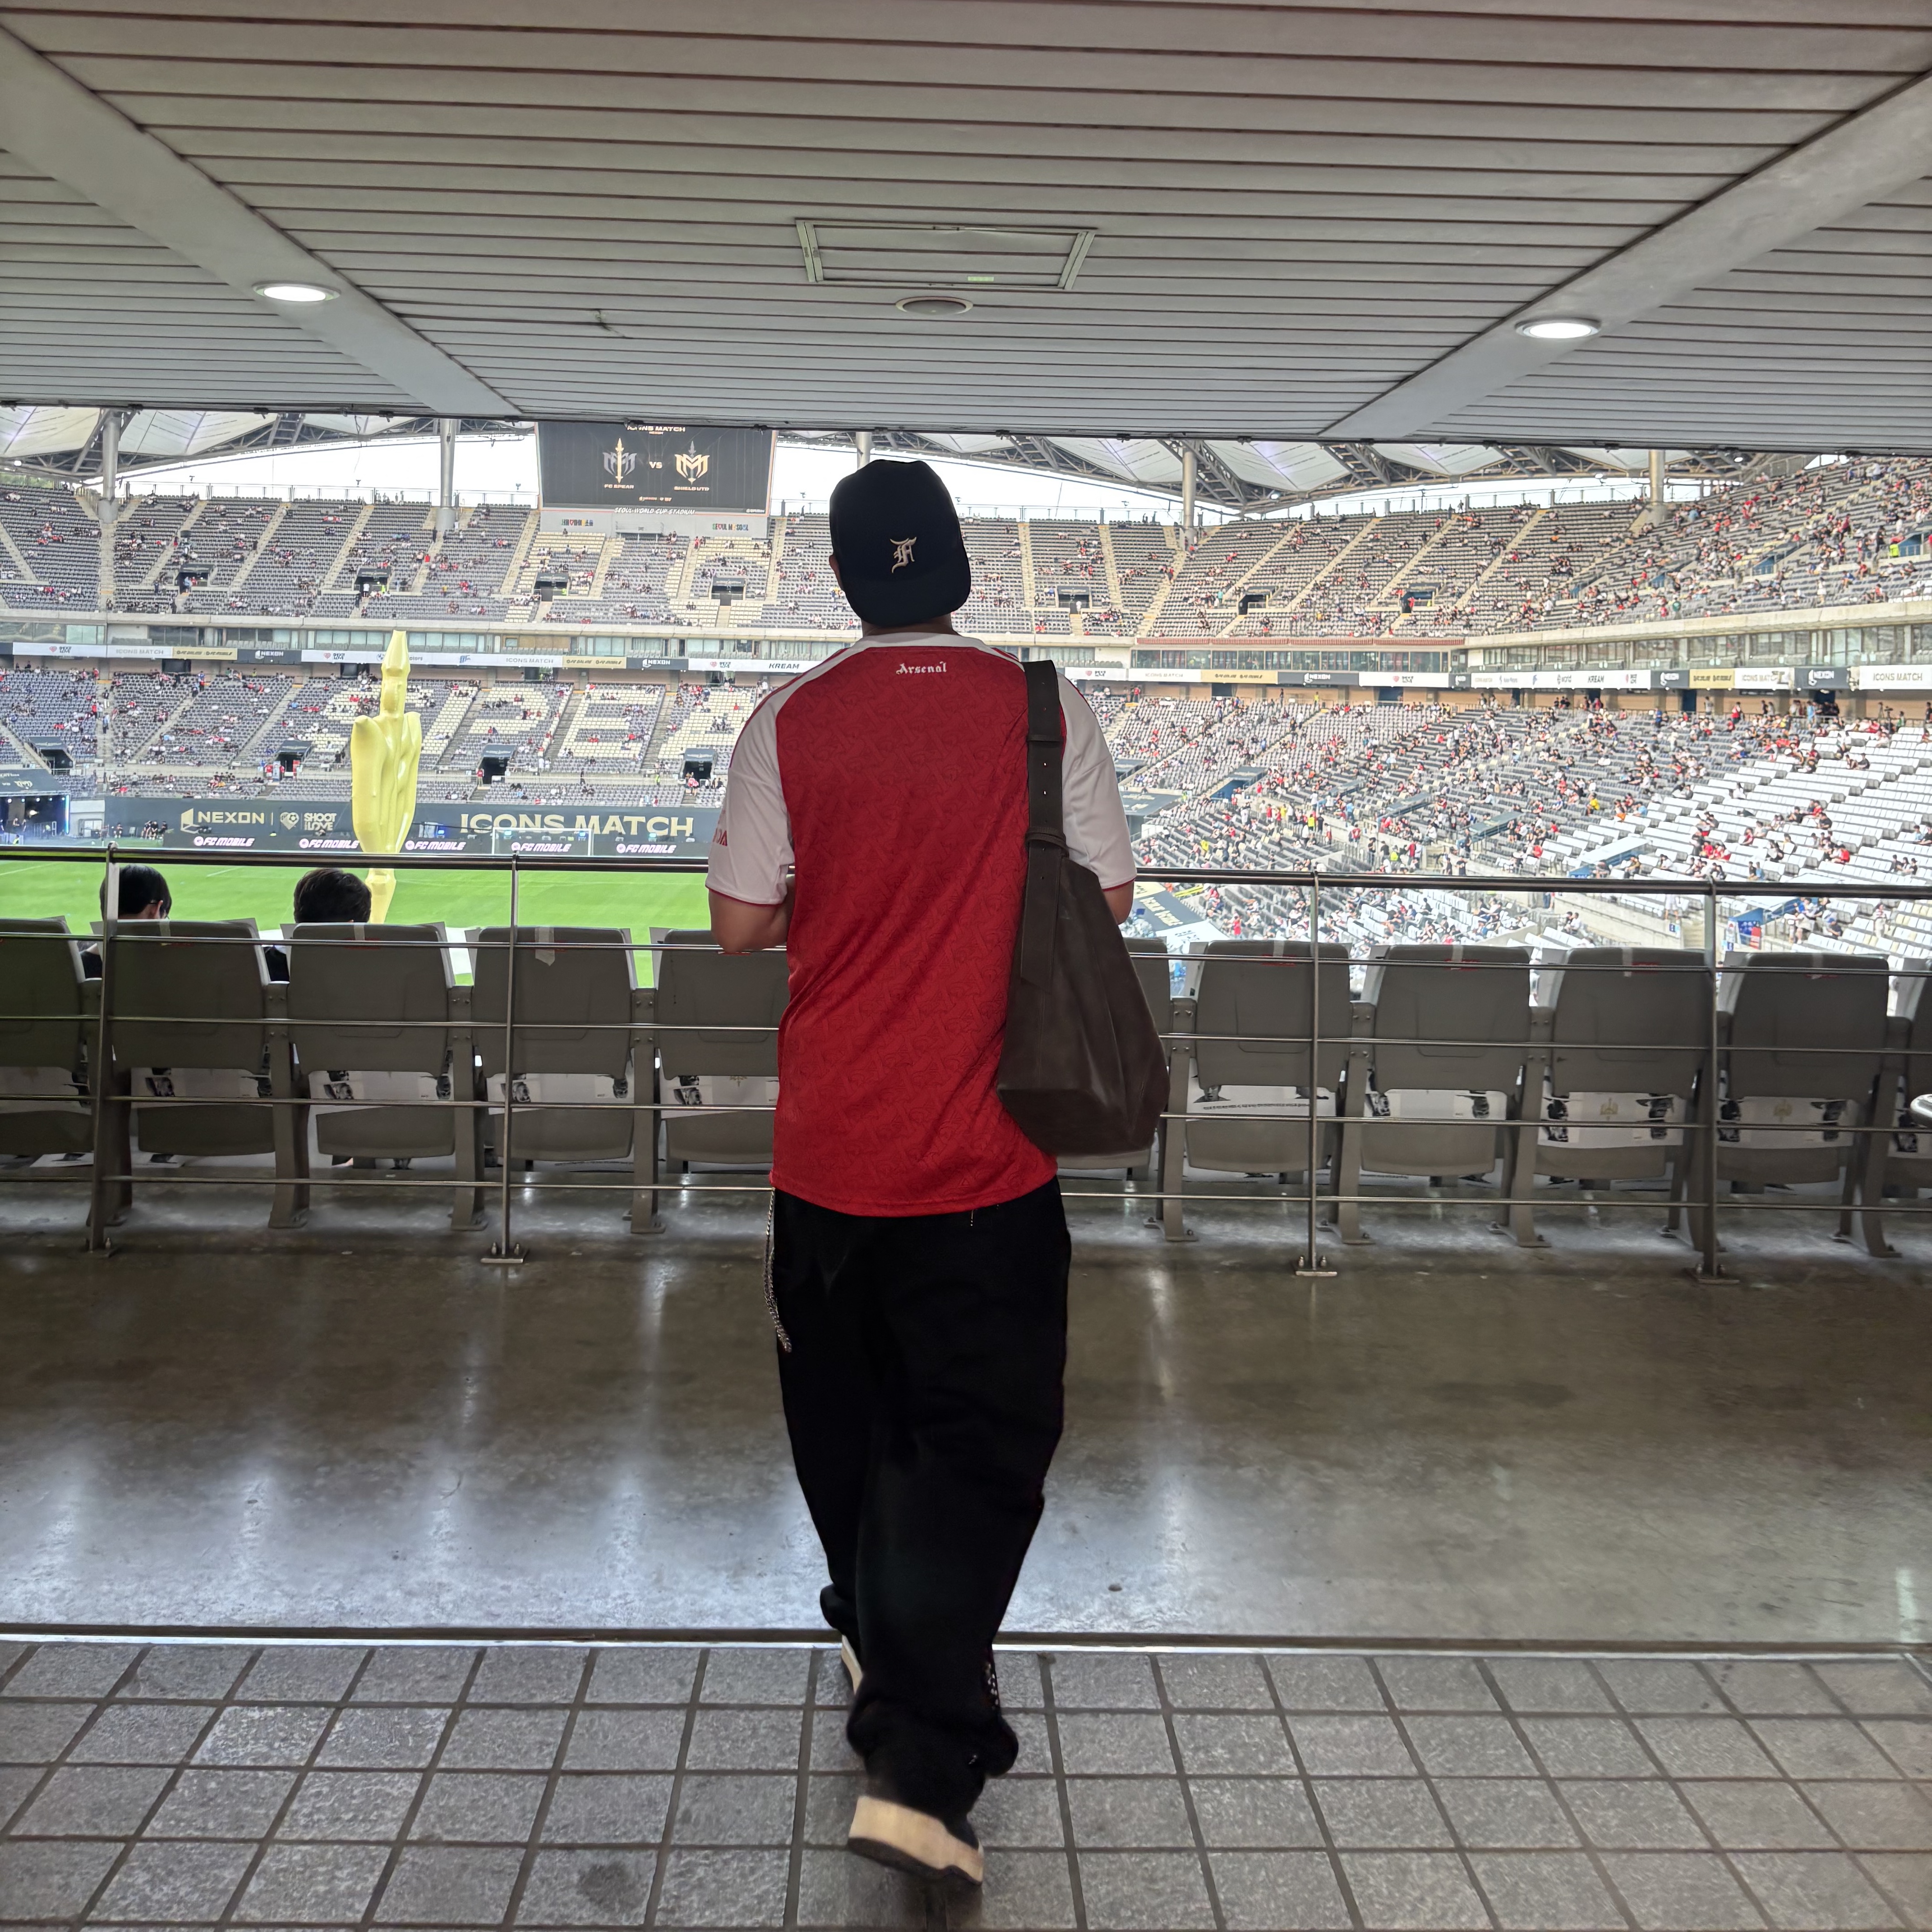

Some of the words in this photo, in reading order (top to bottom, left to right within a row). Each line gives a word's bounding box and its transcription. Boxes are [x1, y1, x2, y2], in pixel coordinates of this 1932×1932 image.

[896, 661, 947, 675] Arsenal
[1873, 672, 1895, 681] ICONS
[1896, 672, 1923, 681] MATCH
[198, 811, 264, 824] NEXON
[304, 813, 337, 822] SHOOT
[308, 822, 333, 831] LOVE
[460, 814, 565, 834] ICONS
[575, 815, 694, 837] MATCH
[203, 837, 217, 846] FC
[216, 837, 255, 846] MOBILE
[309, 839, 323, 848] FC
[321, 840, 359, 848] MOBILE
[414, 841, 429, 849] FC
[428, 842, 466, 850] MOBILE
[520, 843, 535, 851] FC
[533, 843, 572, 852] MOBILE
[626, 844, 640, 853] FC
[638, 844, 677, 853] MOBILE
